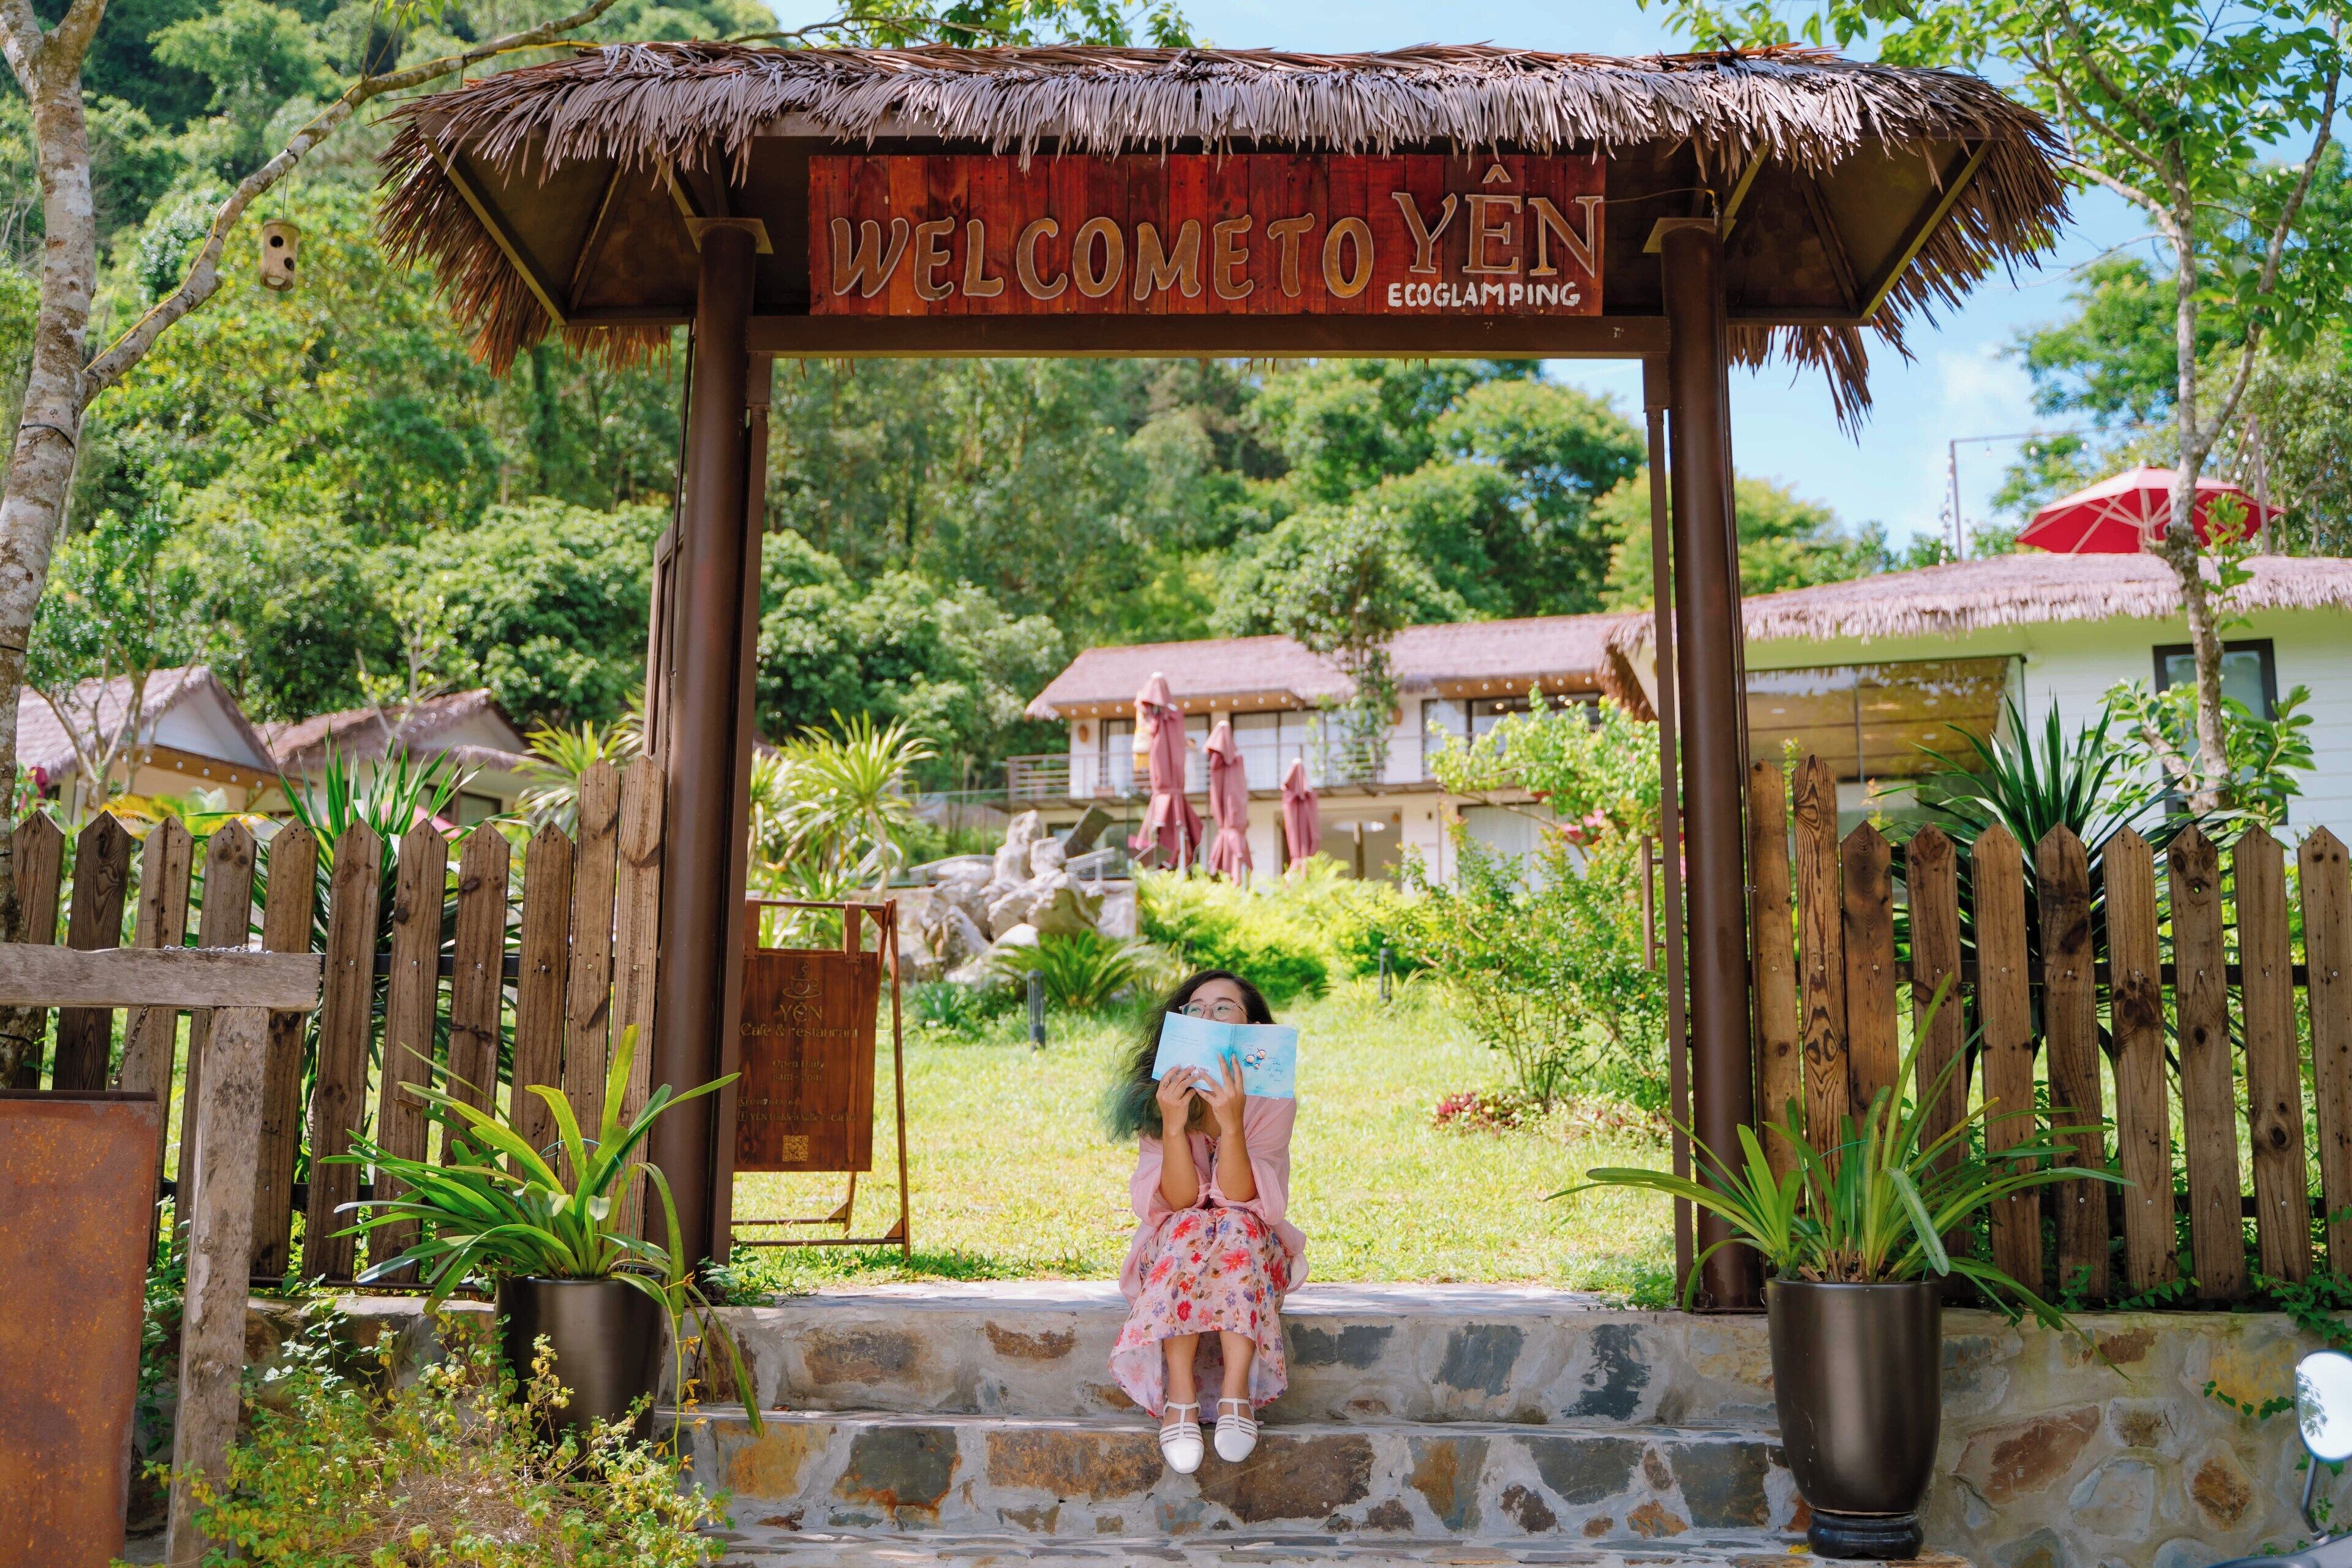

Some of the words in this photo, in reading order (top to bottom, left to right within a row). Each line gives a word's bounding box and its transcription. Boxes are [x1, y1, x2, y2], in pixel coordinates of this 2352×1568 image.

[831, 214, 1254, 301] WELCOME
[1267, 212, 1374, 298] TO
[1392, 164, 1604, 278] YÊN
[1388, 281, 1580, 307] ECOGLAMPING
[780, 1001, 822, 1022] YÊN
[775, 1023, 784, 1036] &
[789, 1027, 858, 1038] restaurant
[772, 1060, 798, 1069] Open
[801, 1058, 824, 1070] Daily
